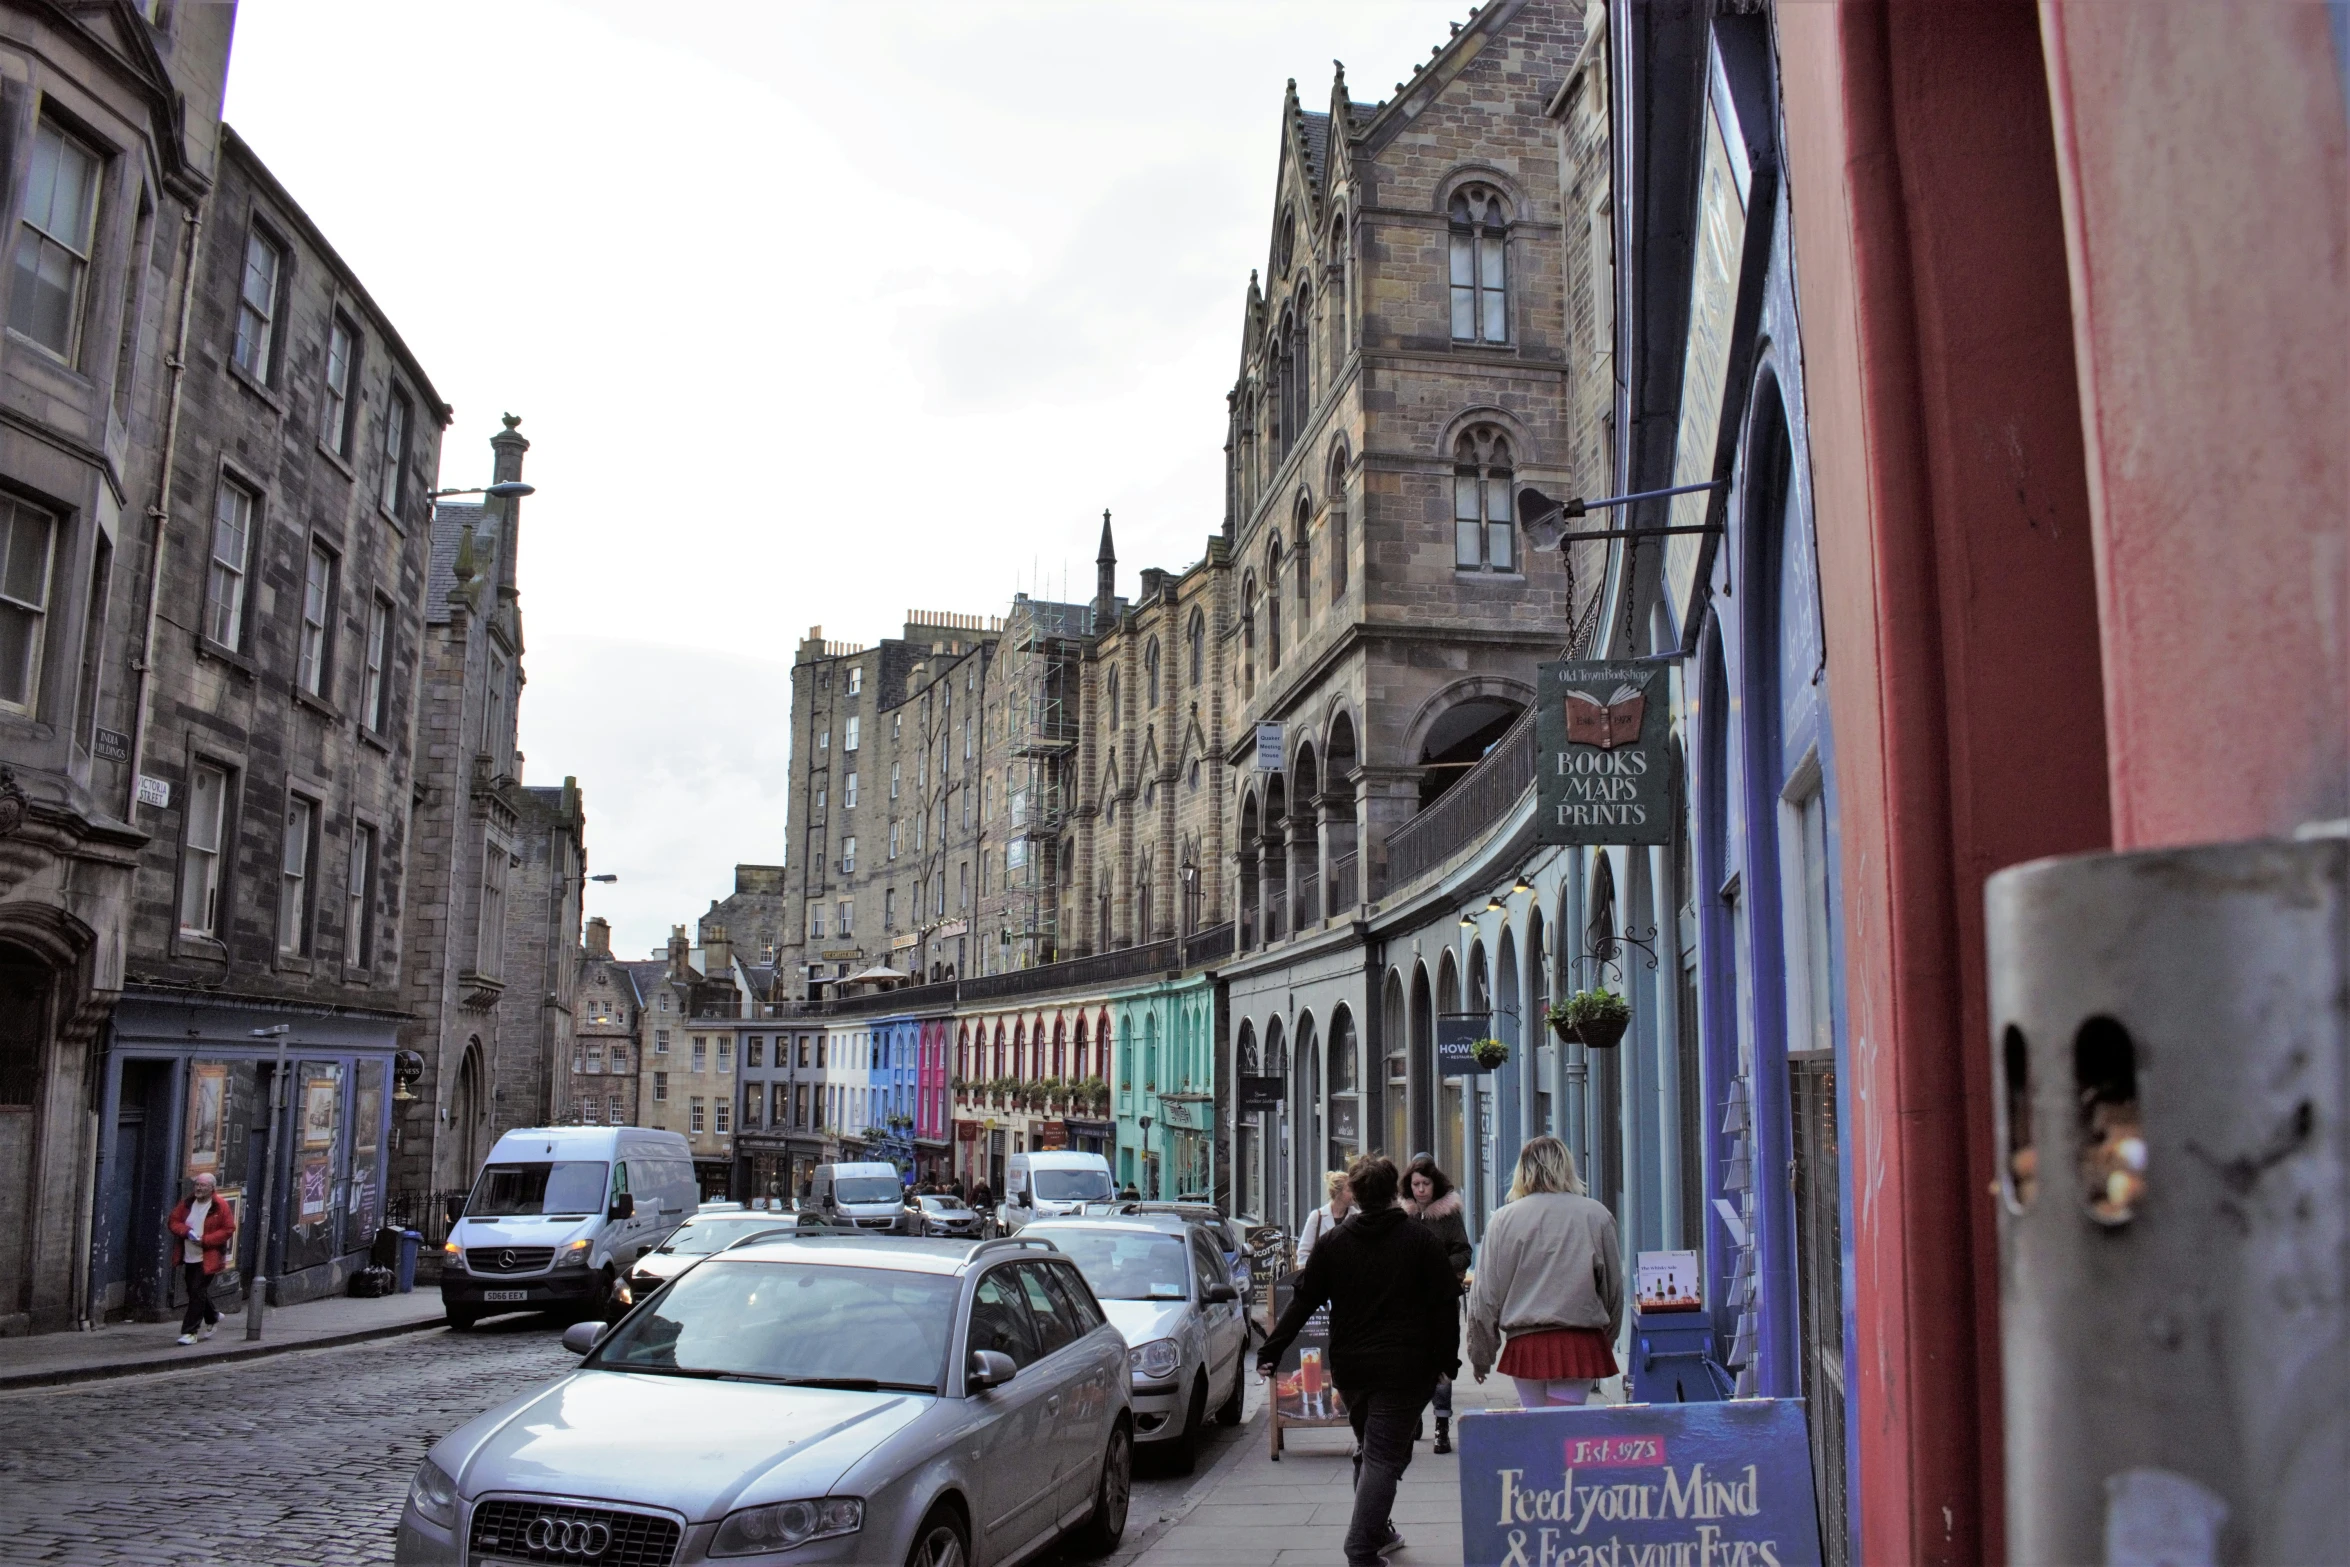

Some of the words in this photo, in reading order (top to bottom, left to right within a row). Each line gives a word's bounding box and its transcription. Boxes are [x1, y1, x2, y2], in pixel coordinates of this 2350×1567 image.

[1558, 668, 1577, 682] Old
[1578, 668, 1604, 682] Town
[1604, 668, 1648, 683] Bookshop
[100, 731, 119, 746] INDIA
[95, 742, 126, 759] UILDINGS
[1556, 750, 1648, 776] BOOKS
[139, 789, 164, 805] STREET
[1560, 777, 1638, 802] MAPS
[1555, 803, 1647, 826] PRINTS
[487, 1291, 507, 1300] SD66
[508, 1291, 524, 1300] EEX
[1496, 1467, 1574, 1526] Feed
[1570, 1483, 1659, 1536] your
[1653, 1462, 1761, 1520] Mind
[1500, 1528, 1532, 1567] &
[1537, 1527, 1623, 1567] Feast
[1626, 1540, 1700, 1567] your
[1695, 1525, 1781, 1567] Eyes
